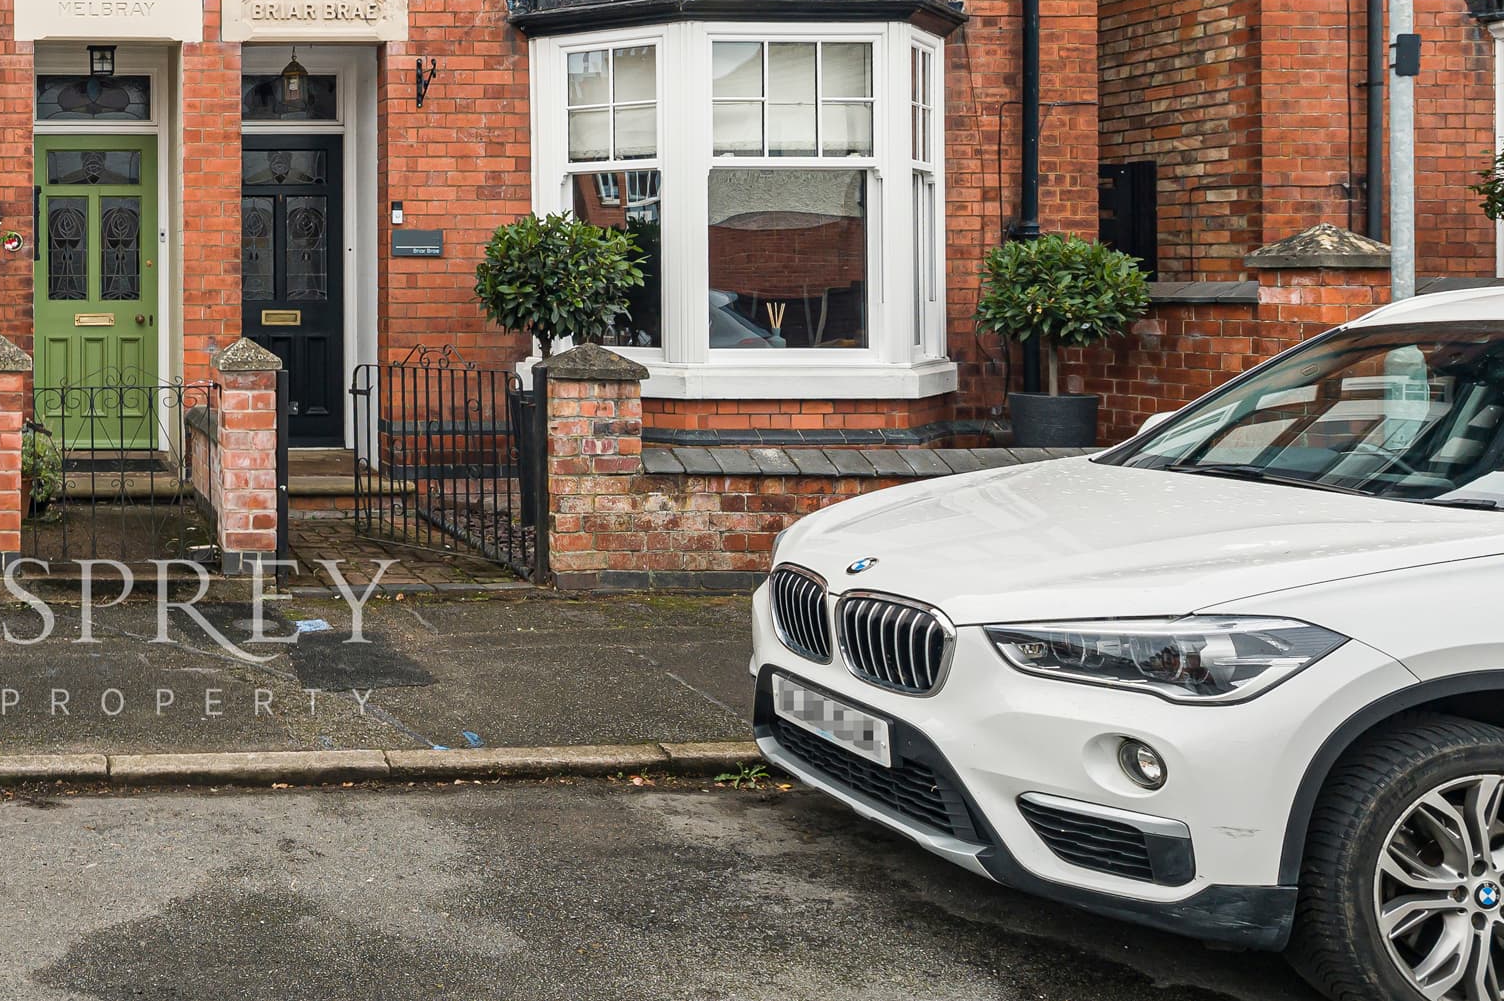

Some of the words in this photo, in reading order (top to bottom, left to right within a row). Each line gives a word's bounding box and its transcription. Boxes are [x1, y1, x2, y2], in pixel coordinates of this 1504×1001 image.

[57, 1, 156, 17] MELBRAY
[251, 2, 316, 21] BRIAR
[323, 2, 377, 21] BRAE
